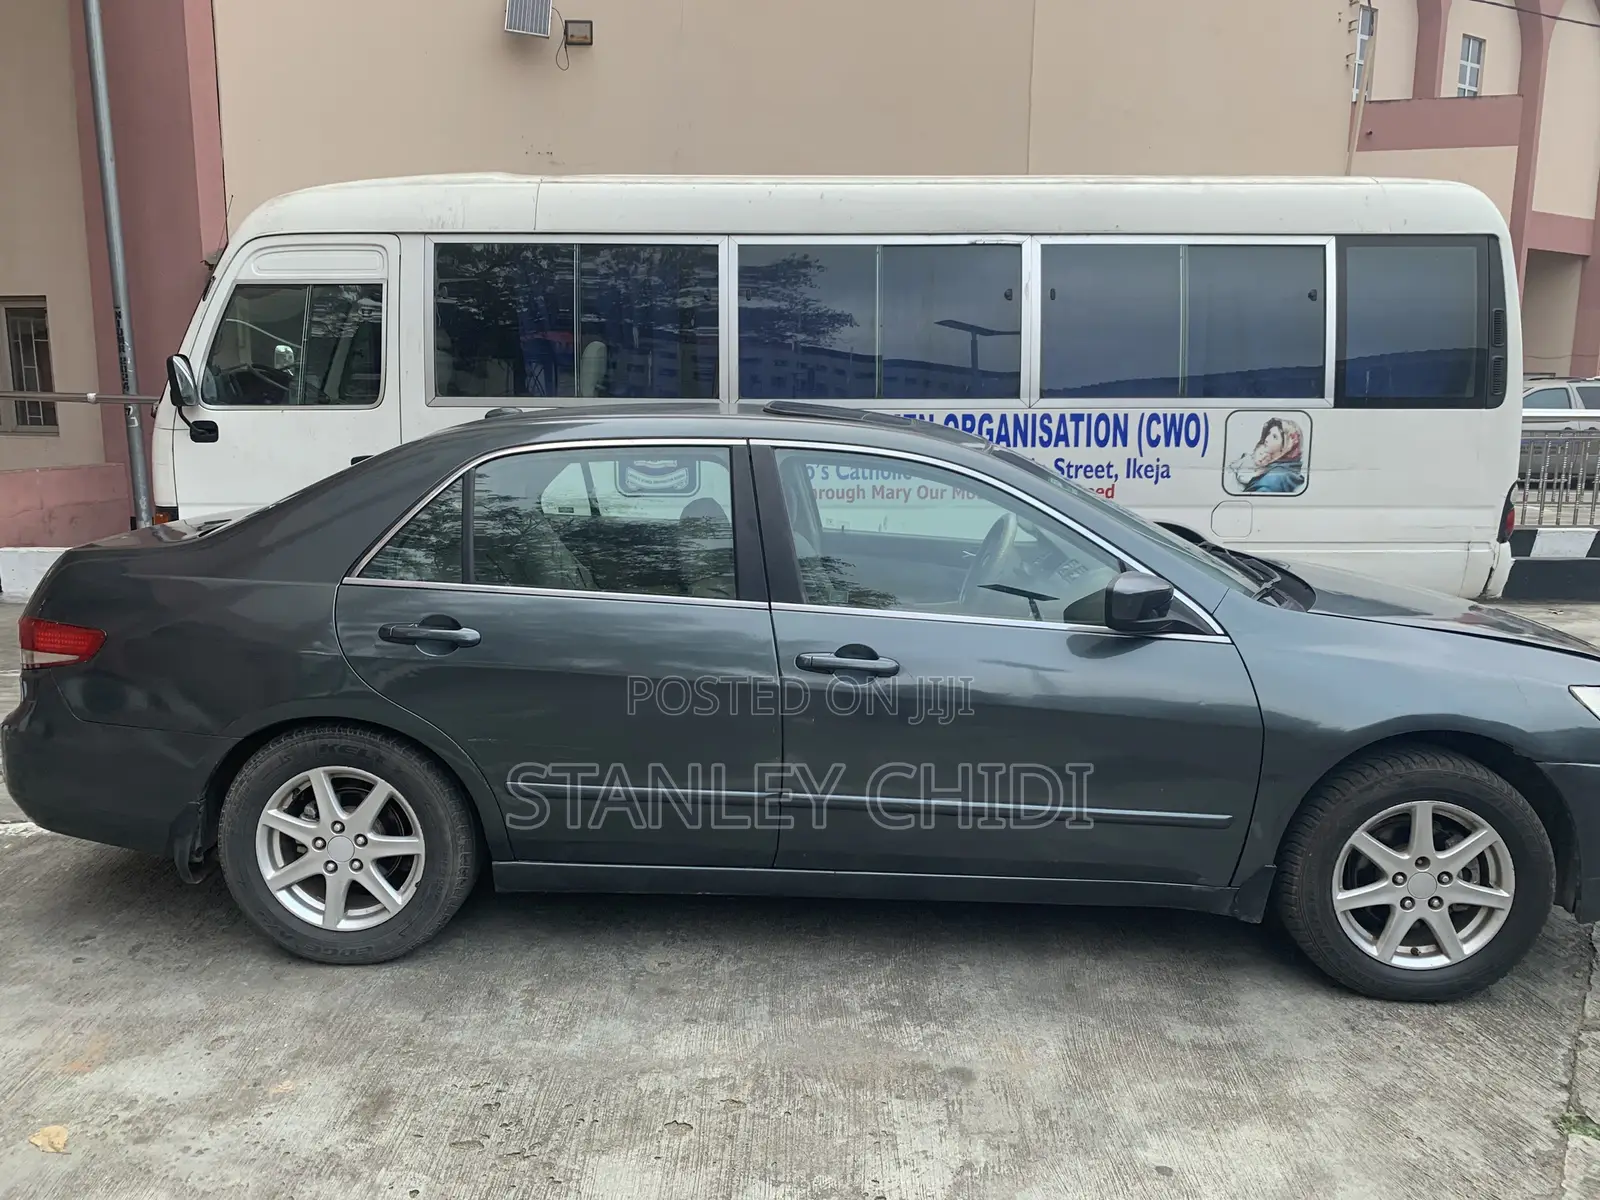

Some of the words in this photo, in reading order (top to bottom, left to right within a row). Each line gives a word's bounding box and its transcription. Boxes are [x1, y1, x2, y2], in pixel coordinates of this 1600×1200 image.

[1137, 412, 1210, 458] (CWO)
[1053, 457, 1119, 482] Street,
[1125, 457, 1171, 485] Ikeja
[812, 484, 866, 503] rough
[871, 484, 912, 503] Mary
[916, 484, 947, 500] Our
